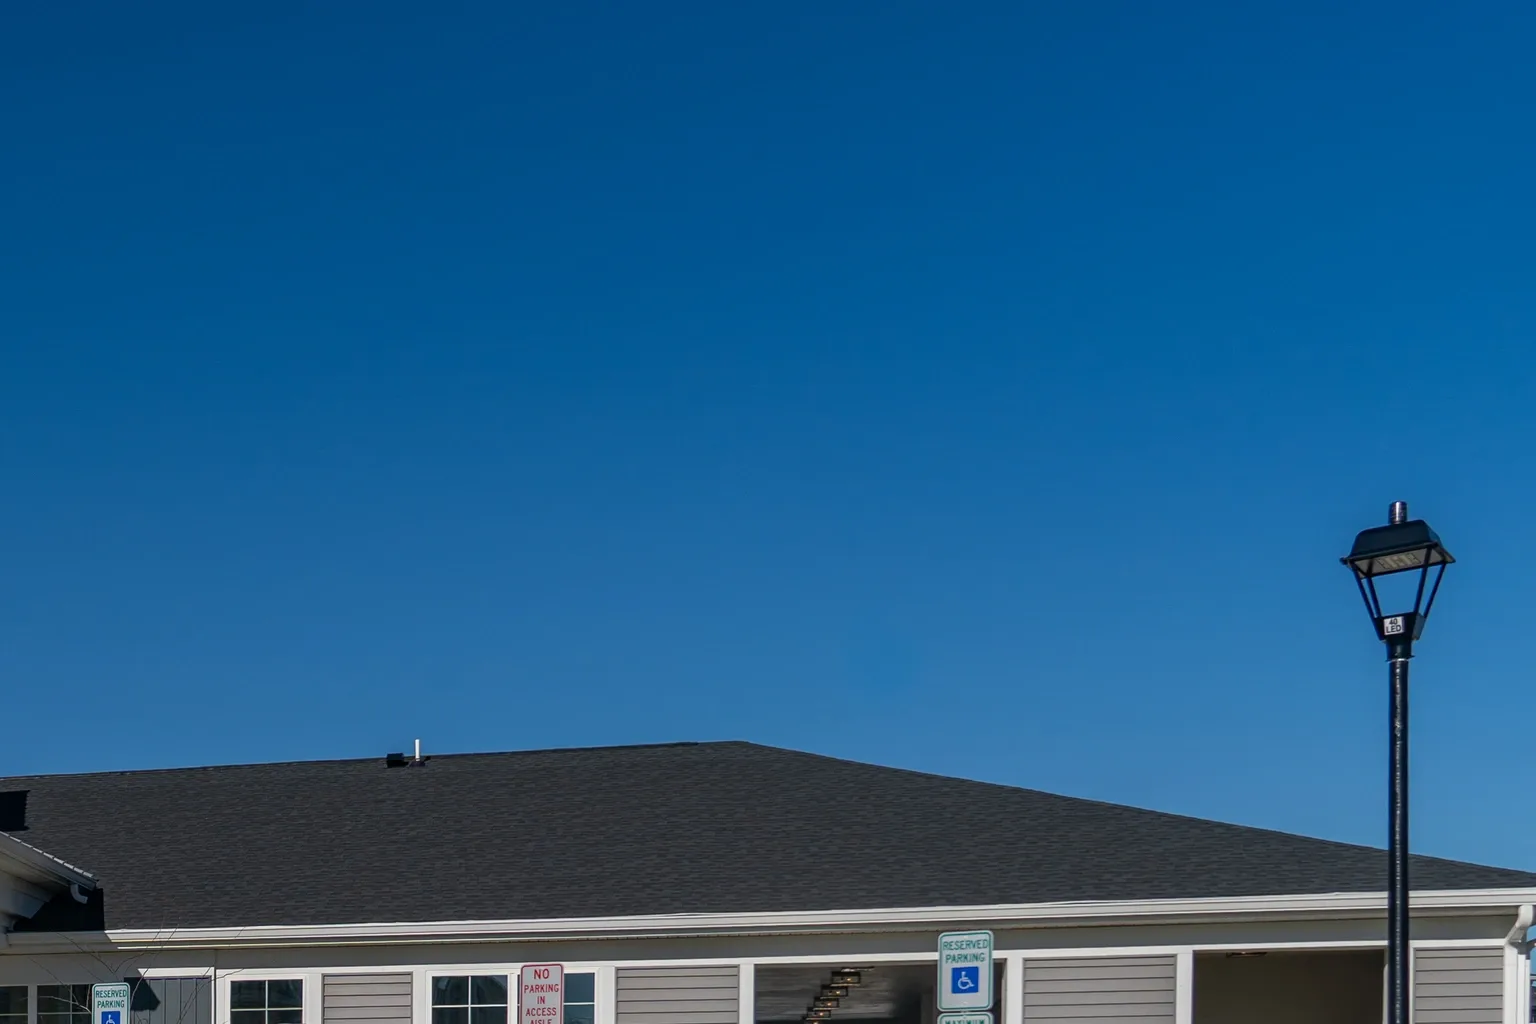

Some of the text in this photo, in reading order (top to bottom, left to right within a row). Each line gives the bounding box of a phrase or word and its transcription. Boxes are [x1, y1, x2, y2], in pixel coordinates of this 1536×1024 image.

[1386, 625, 1402, 633] LED
[943, 940, 989, 950] RESERVED
[945, 953, 985, 963] PARKING
[534, 968, 550, 979] NO
[524, 984, 559, 993] PARKING
[95, 990, 127, 998] RESERVED
[97, 1000, 125, 1008] PARKING
[537, 996, 545, 1004] IN
[525, 1007, 557, 1017] ACCESS
